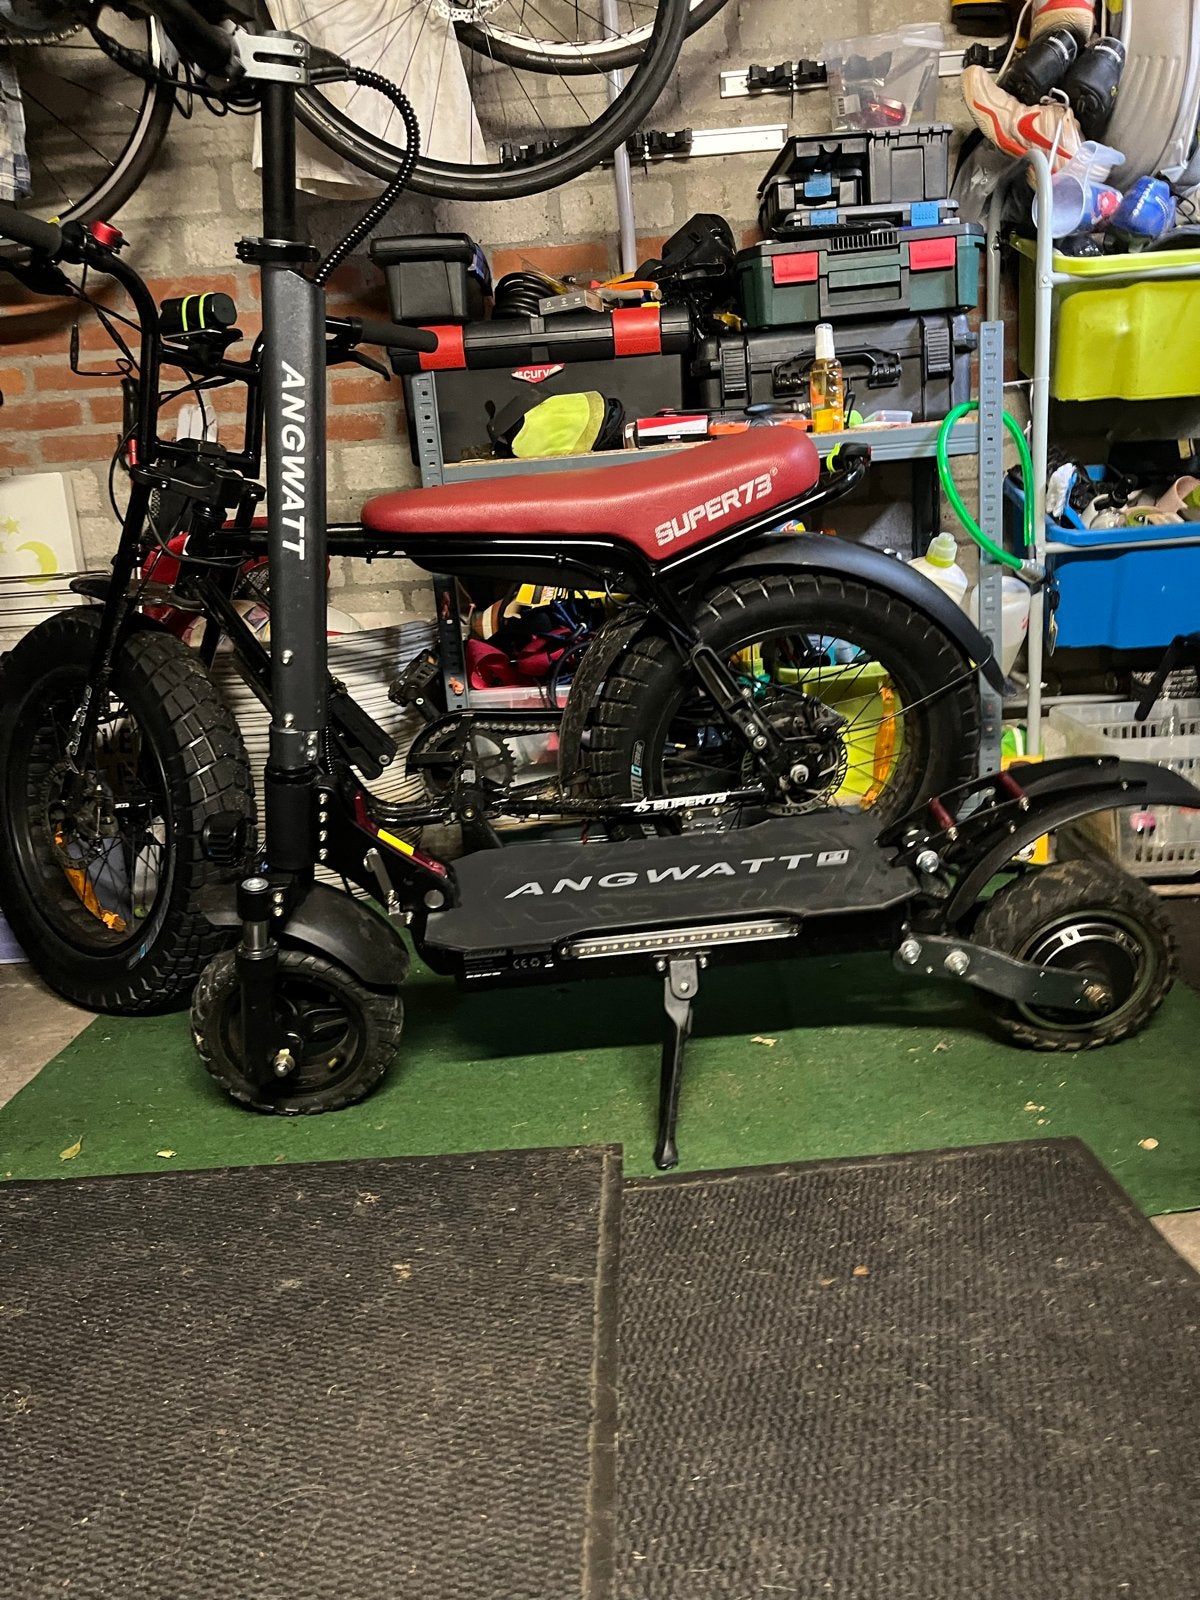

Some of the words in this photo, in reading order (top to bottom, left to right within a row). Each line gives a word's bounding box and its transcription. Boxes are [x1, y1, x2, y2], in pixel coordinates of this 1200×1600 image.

[281, 360, 306, 561] ANGWATT
[652, 793, 729, 811] SUPER73
[503, 853, 814, 900] ANGWATT
